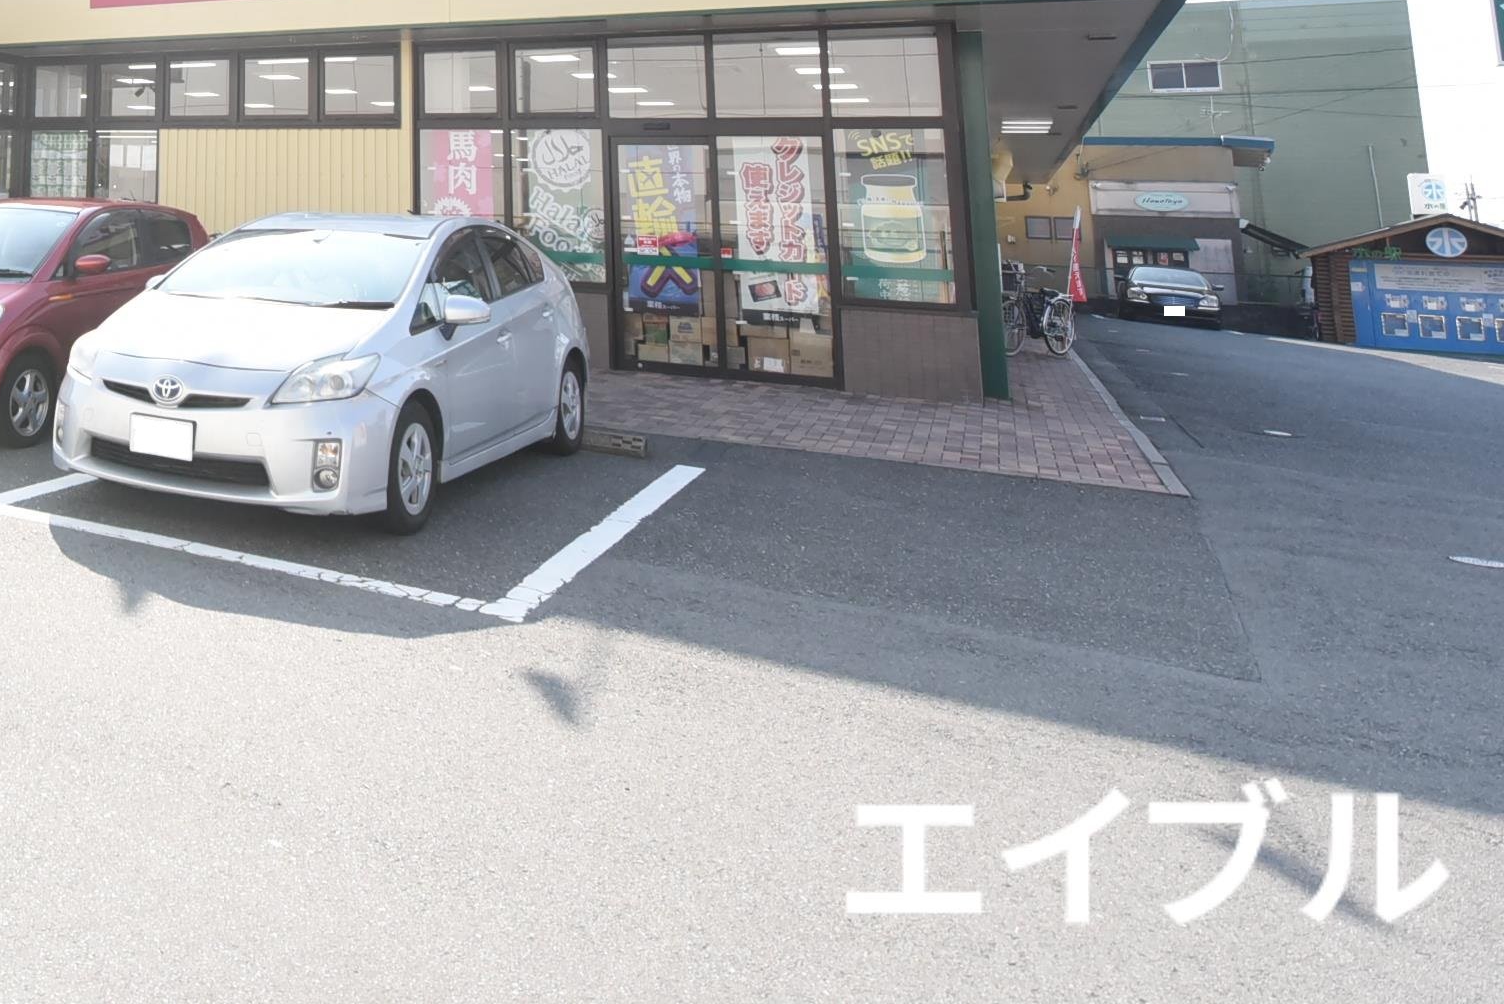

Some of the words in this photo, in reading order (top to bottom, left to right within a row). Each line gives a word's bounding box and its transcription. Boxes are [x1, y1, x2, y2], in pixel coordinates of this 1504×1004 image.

[447, 130, 478, 195] 馬肉
[857, 131, 914, 156] SNSで
[529, 185, 583, 237] Hala
[740, 162, 772, 254] 使えます
